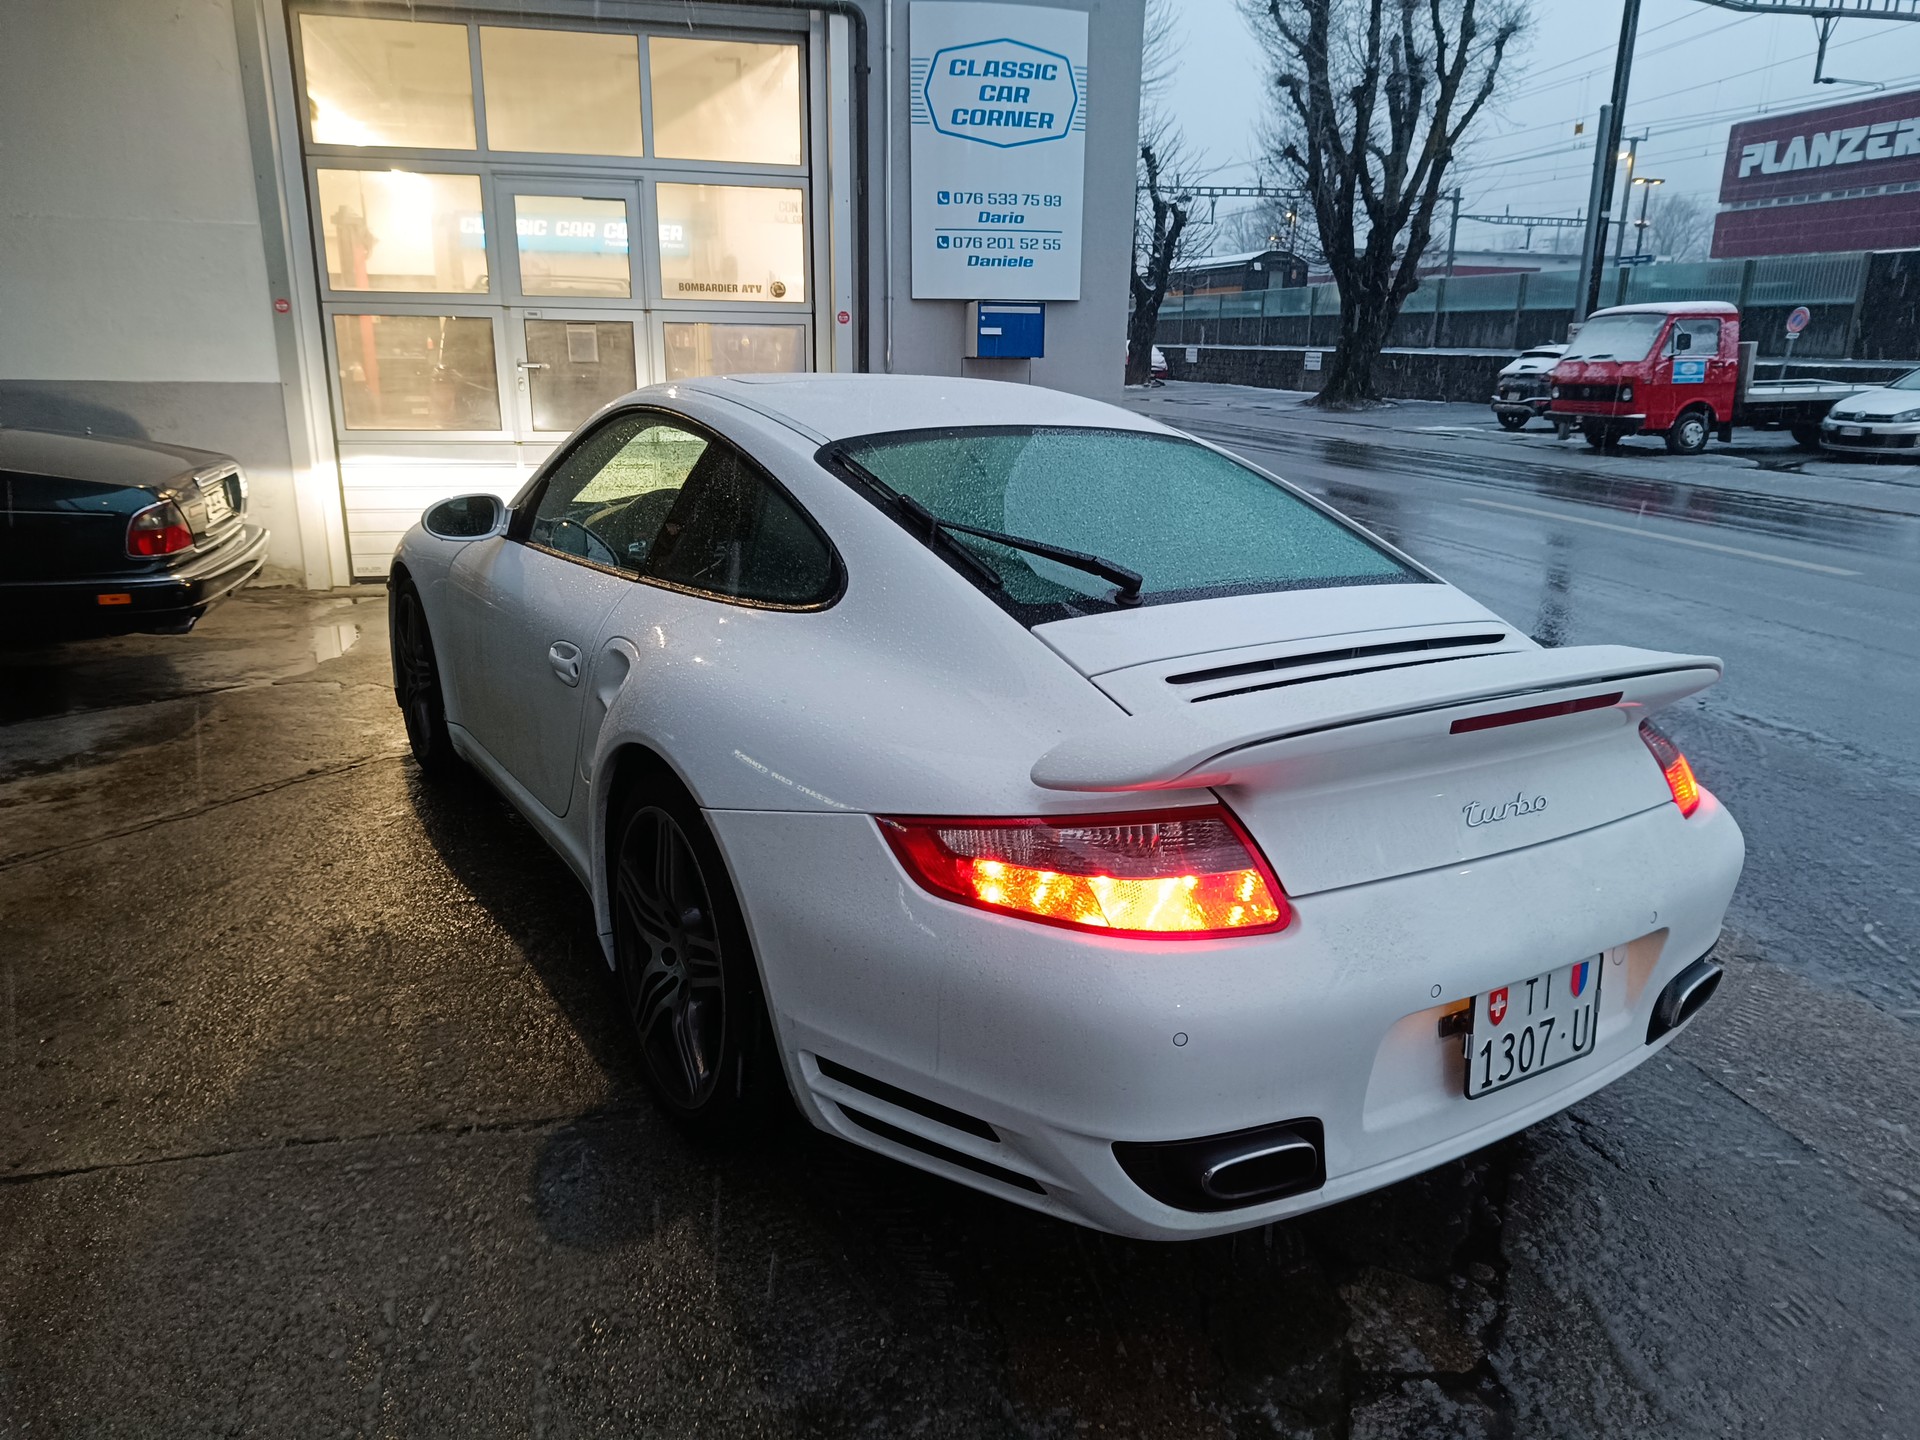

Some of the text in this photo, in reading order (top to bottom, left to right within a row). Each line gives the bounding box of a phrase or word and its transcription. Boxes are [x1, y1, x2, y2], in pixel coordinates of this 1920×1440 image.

[949, 58, 1058, 81] CLASSIC
[979, 84, 1030, 104] CAR
[951, 107, 1054, 129] CORNER
[1738, 117, 1920, 178] PLANZER
[953, 192, 1062, 208] 076 533 75 93
[978, 211, 1025, 224] Dario
[555, 221, 596, 238] CAR
[953, 236, 1062, 251] 076 201 52 55
[967, 255, 1034, 268] Daniele
[678, 282, 762, 294] BOMBARDIER ATV
[1526, 973, 1552, 1016] TI
